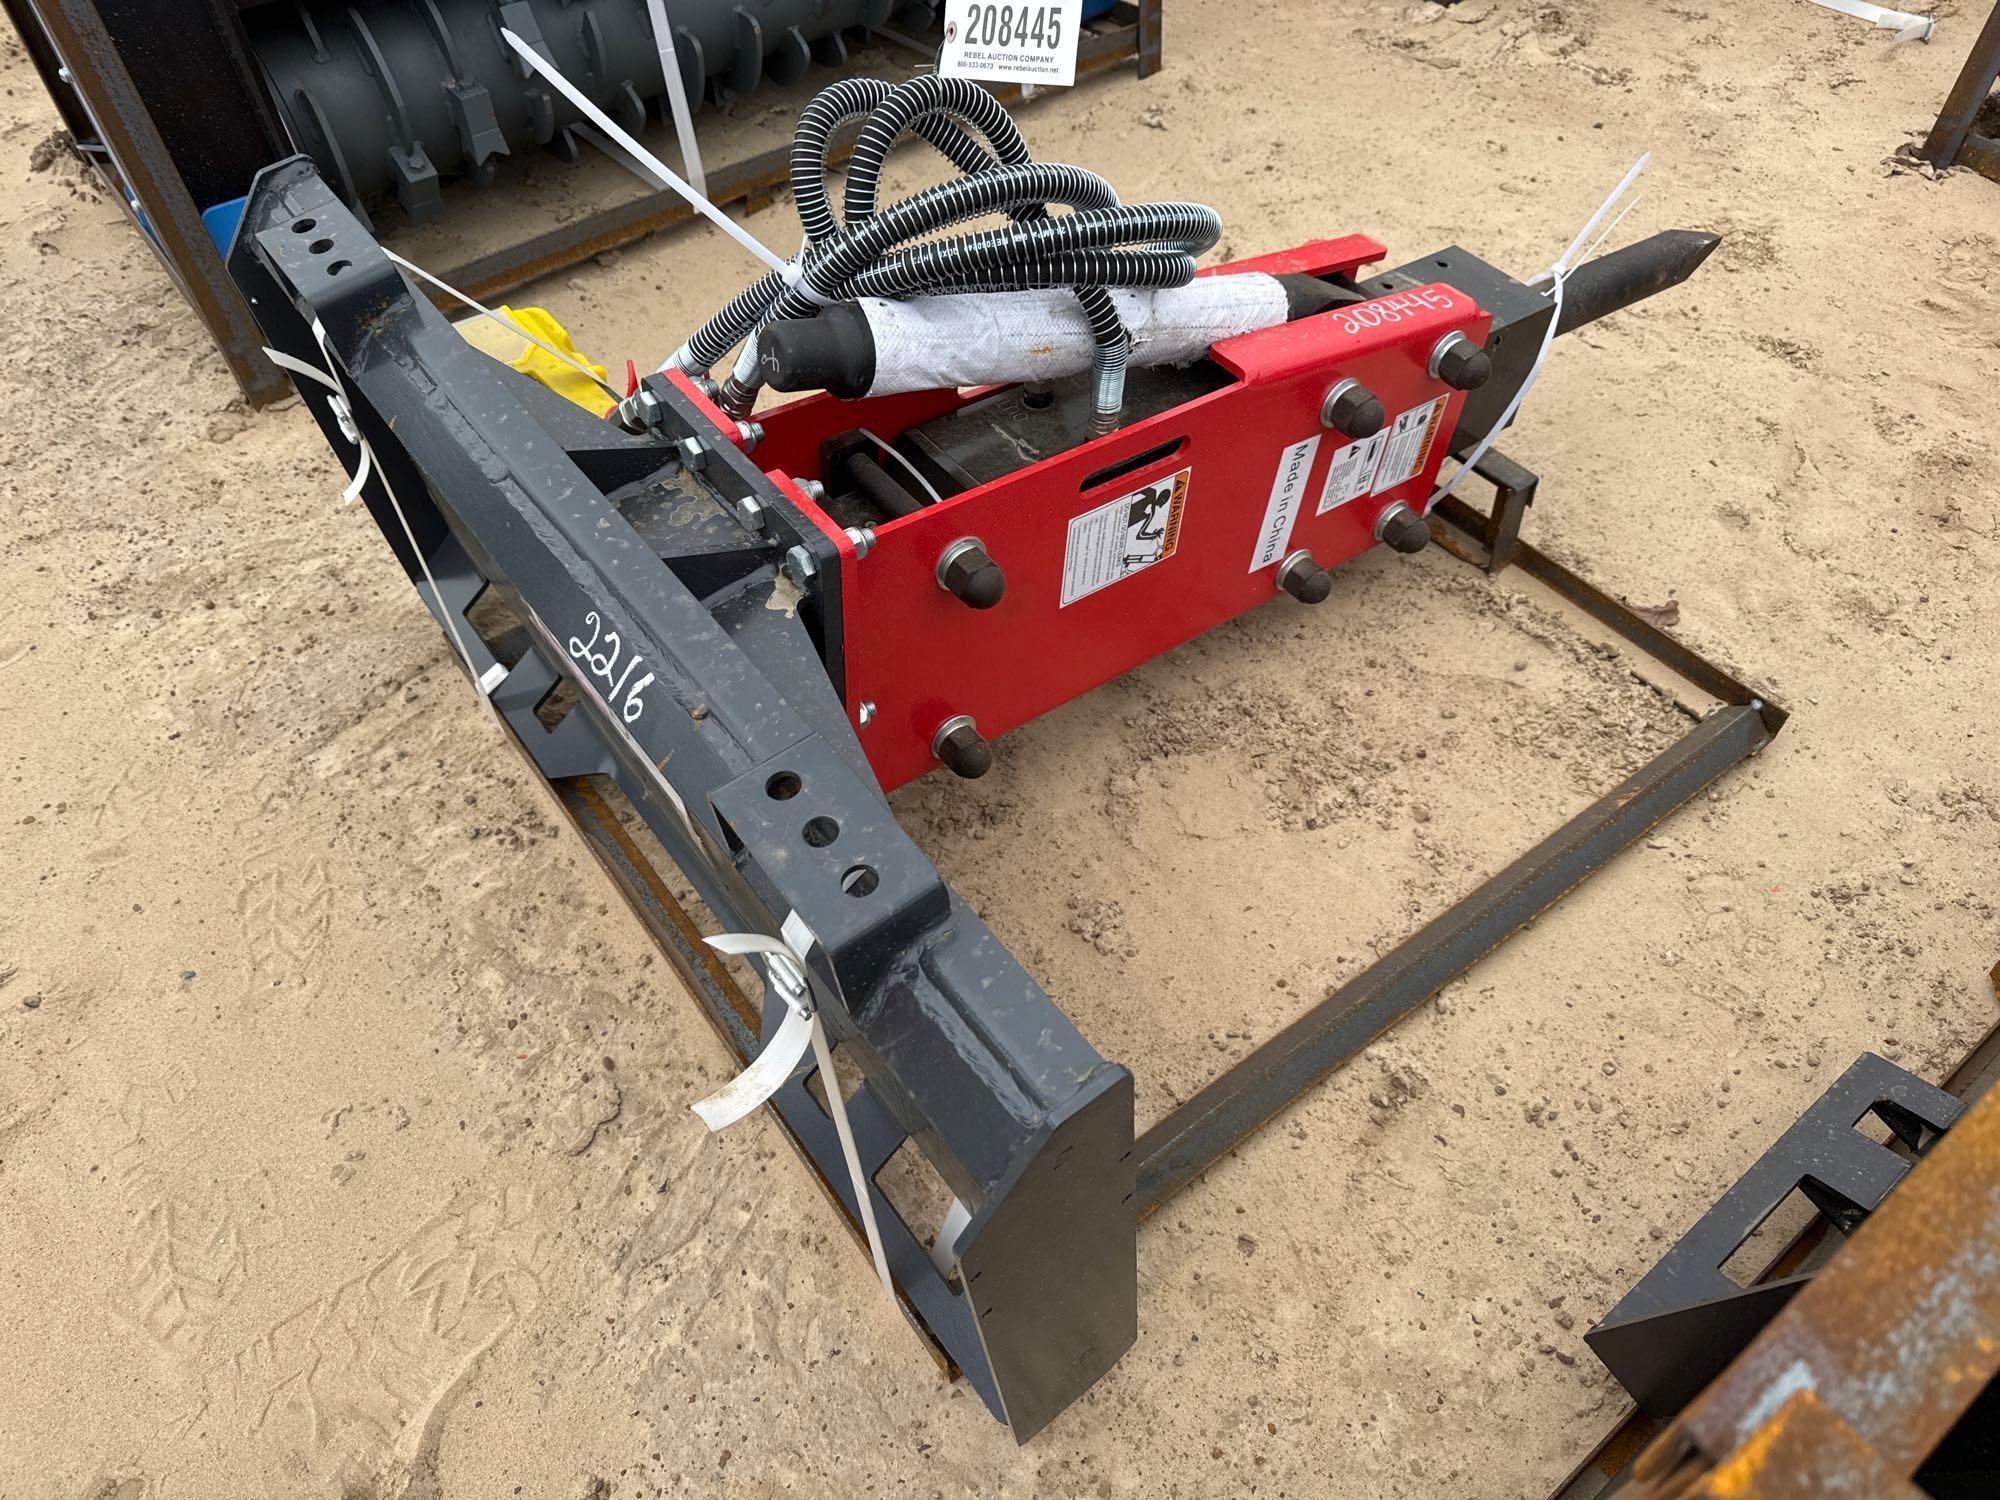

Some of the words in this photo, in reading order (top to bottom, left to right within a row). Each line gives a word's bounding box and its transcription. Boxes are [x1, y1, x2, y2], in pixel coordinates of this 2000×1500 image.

[964, 4, 1063, 50] 208445
[964, 51, 985, 60] REBEL
[987, 53, 1018, 62] AUCTION
[1020, 55, 1054, 63] COMPANY
[1332, 289, 1454, 335] 208445
[1283, 443, 1309, 494] Made
[1164, 492, 1184, 552] WARNING
[1275, 496, 1290, 513] in
[1262, 515, 1287, 564] China
